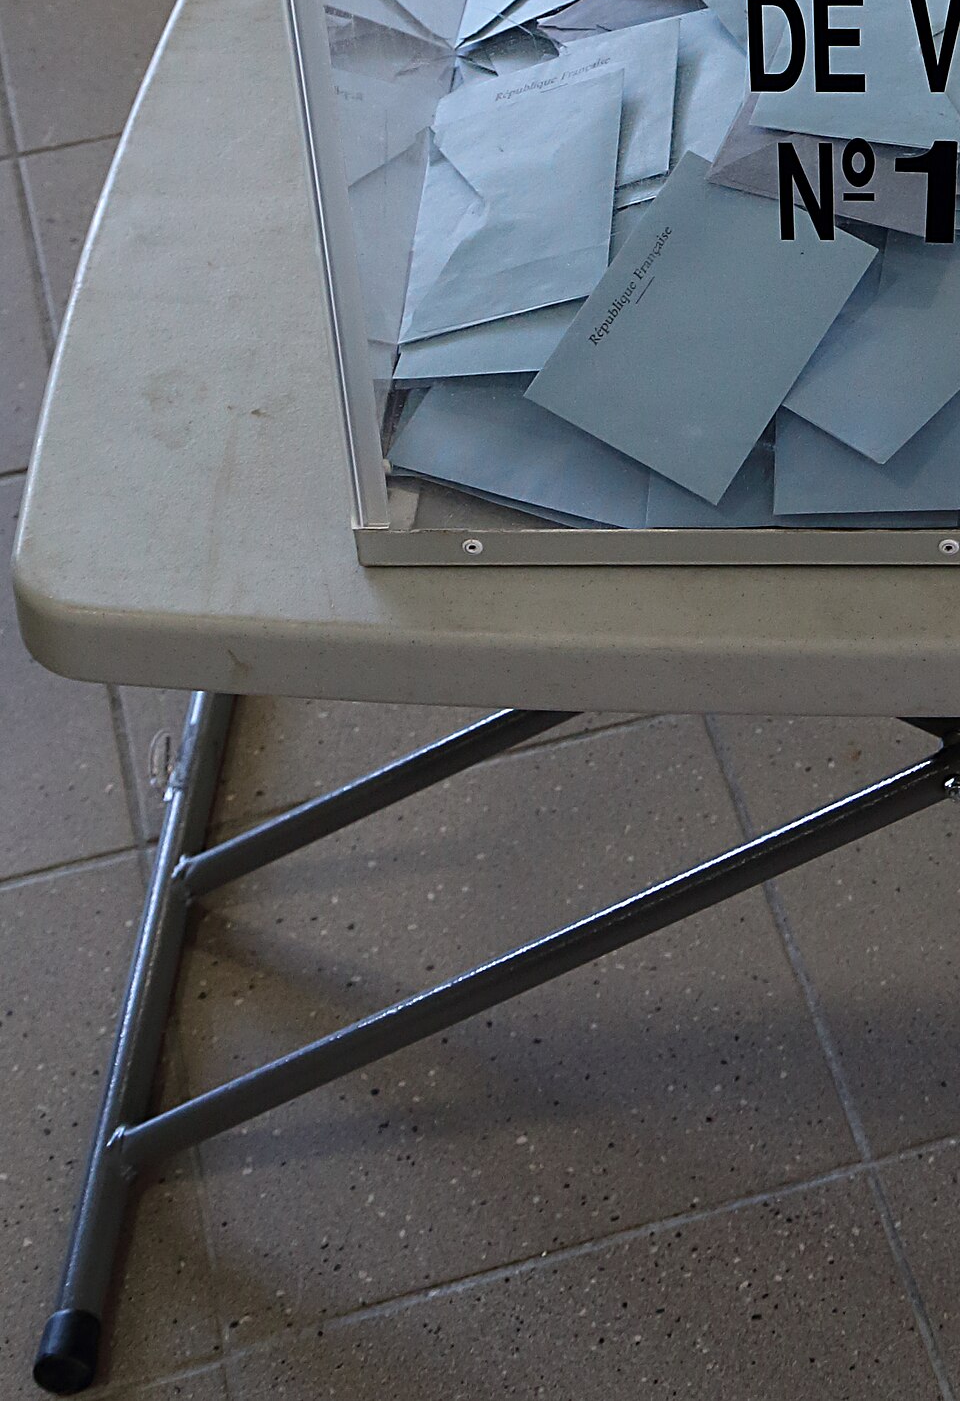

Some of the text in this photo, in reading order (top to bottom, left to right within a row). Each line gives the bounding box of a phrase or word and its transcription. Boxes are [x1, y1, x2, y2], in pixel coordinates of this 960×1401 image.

[495, 77, 558, 102] République
[588, 226, 673, 346] République Française
